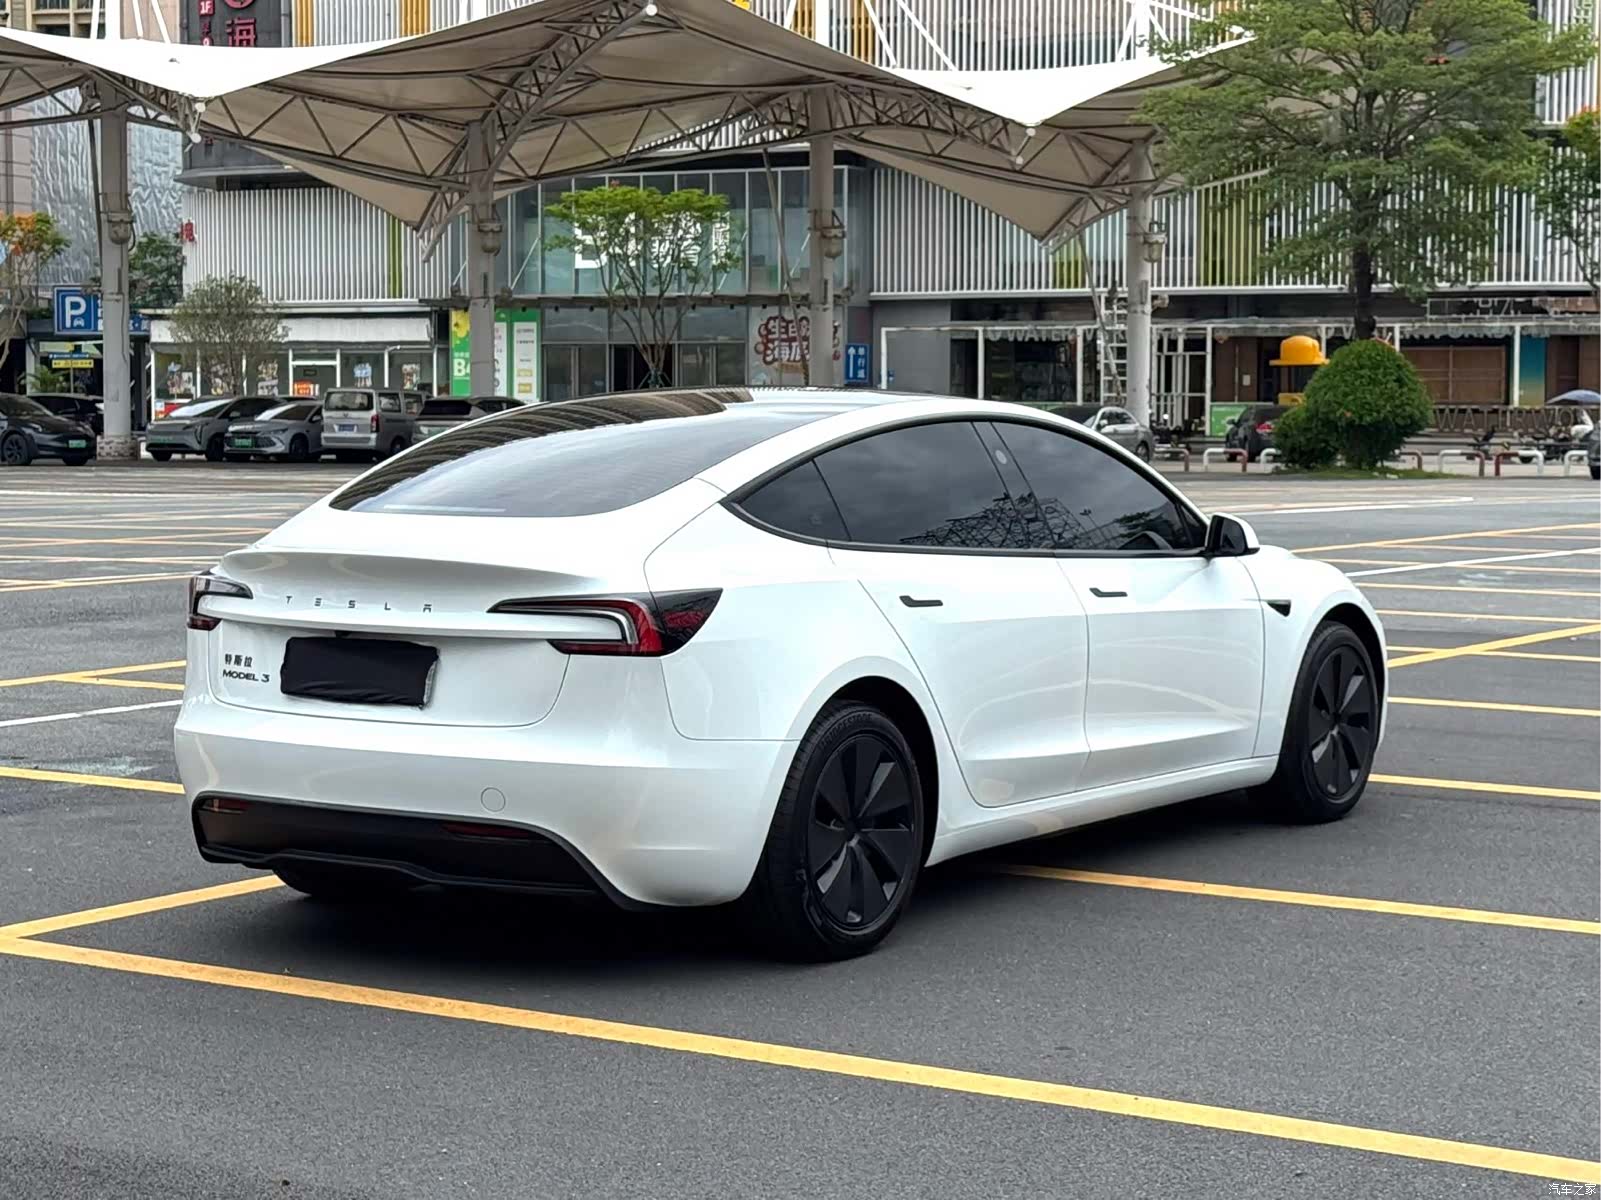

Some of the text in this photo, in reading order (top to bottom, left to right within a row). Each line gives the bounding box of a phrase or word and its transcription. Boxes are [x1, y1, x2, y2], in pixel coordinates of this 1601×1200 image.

[65, 296, 86, 328] P
[286, 596, 432, 613] TESLA
[224, 653, 253, 668] 特斯拉
[222, 669, 270, 683] MODEL 3
